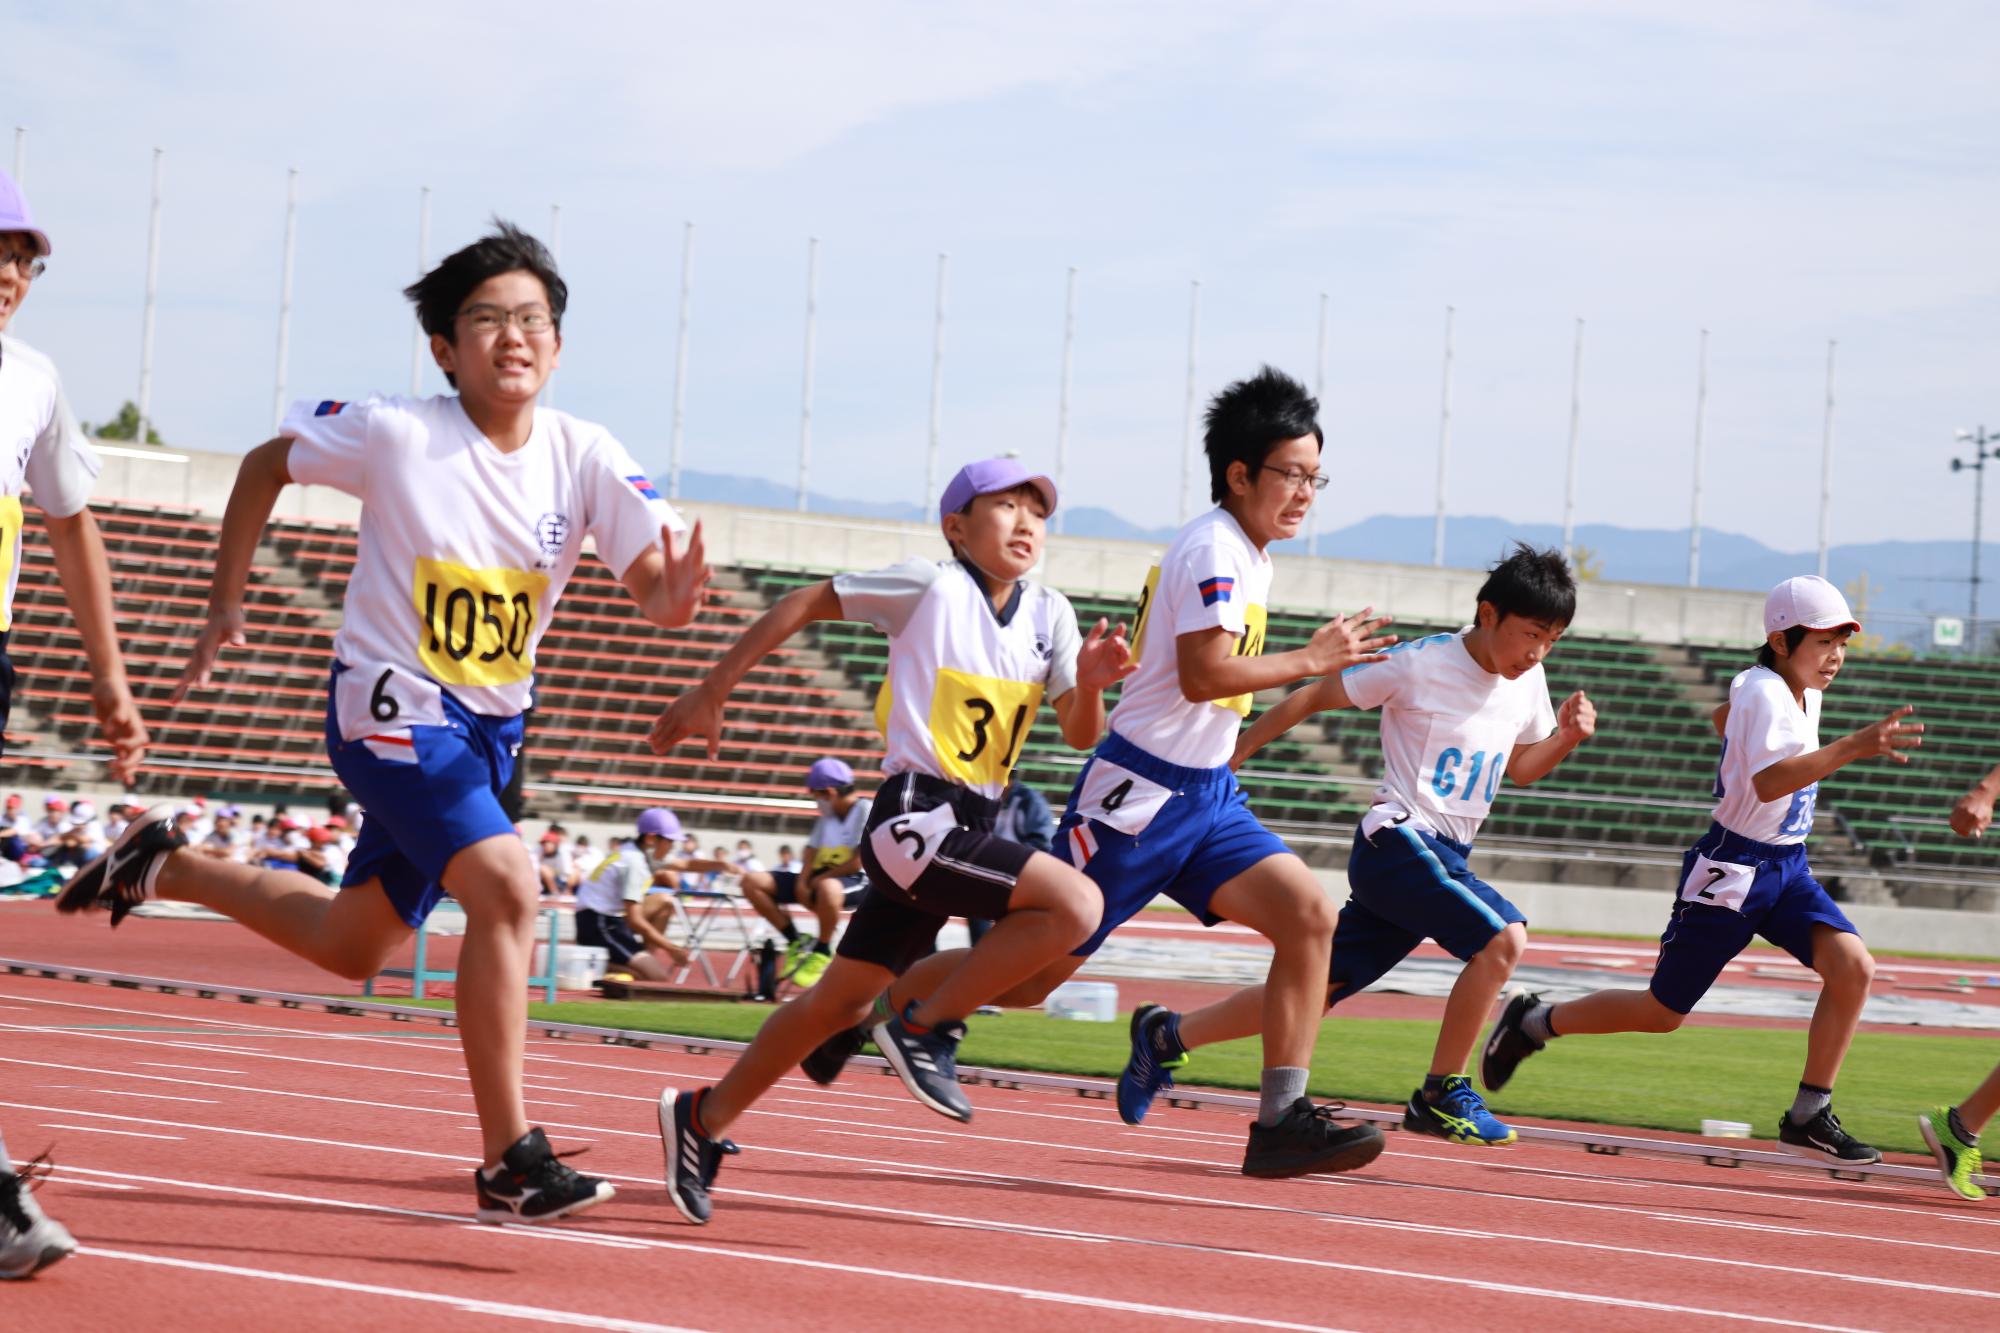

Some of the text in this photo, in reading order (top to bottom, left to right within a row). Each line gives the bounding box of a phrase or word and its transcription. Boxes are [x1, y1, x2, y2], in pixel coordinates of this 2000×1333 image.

[426, 582, 532, 662] 1050
[370, 668, 399, 722] 6
[957, 698, 1028, 767] 31
[1100, 778, 1134, 816] 4
[890, 819, 926, 862] 5
[1697, 867, 1726, 900] 2
